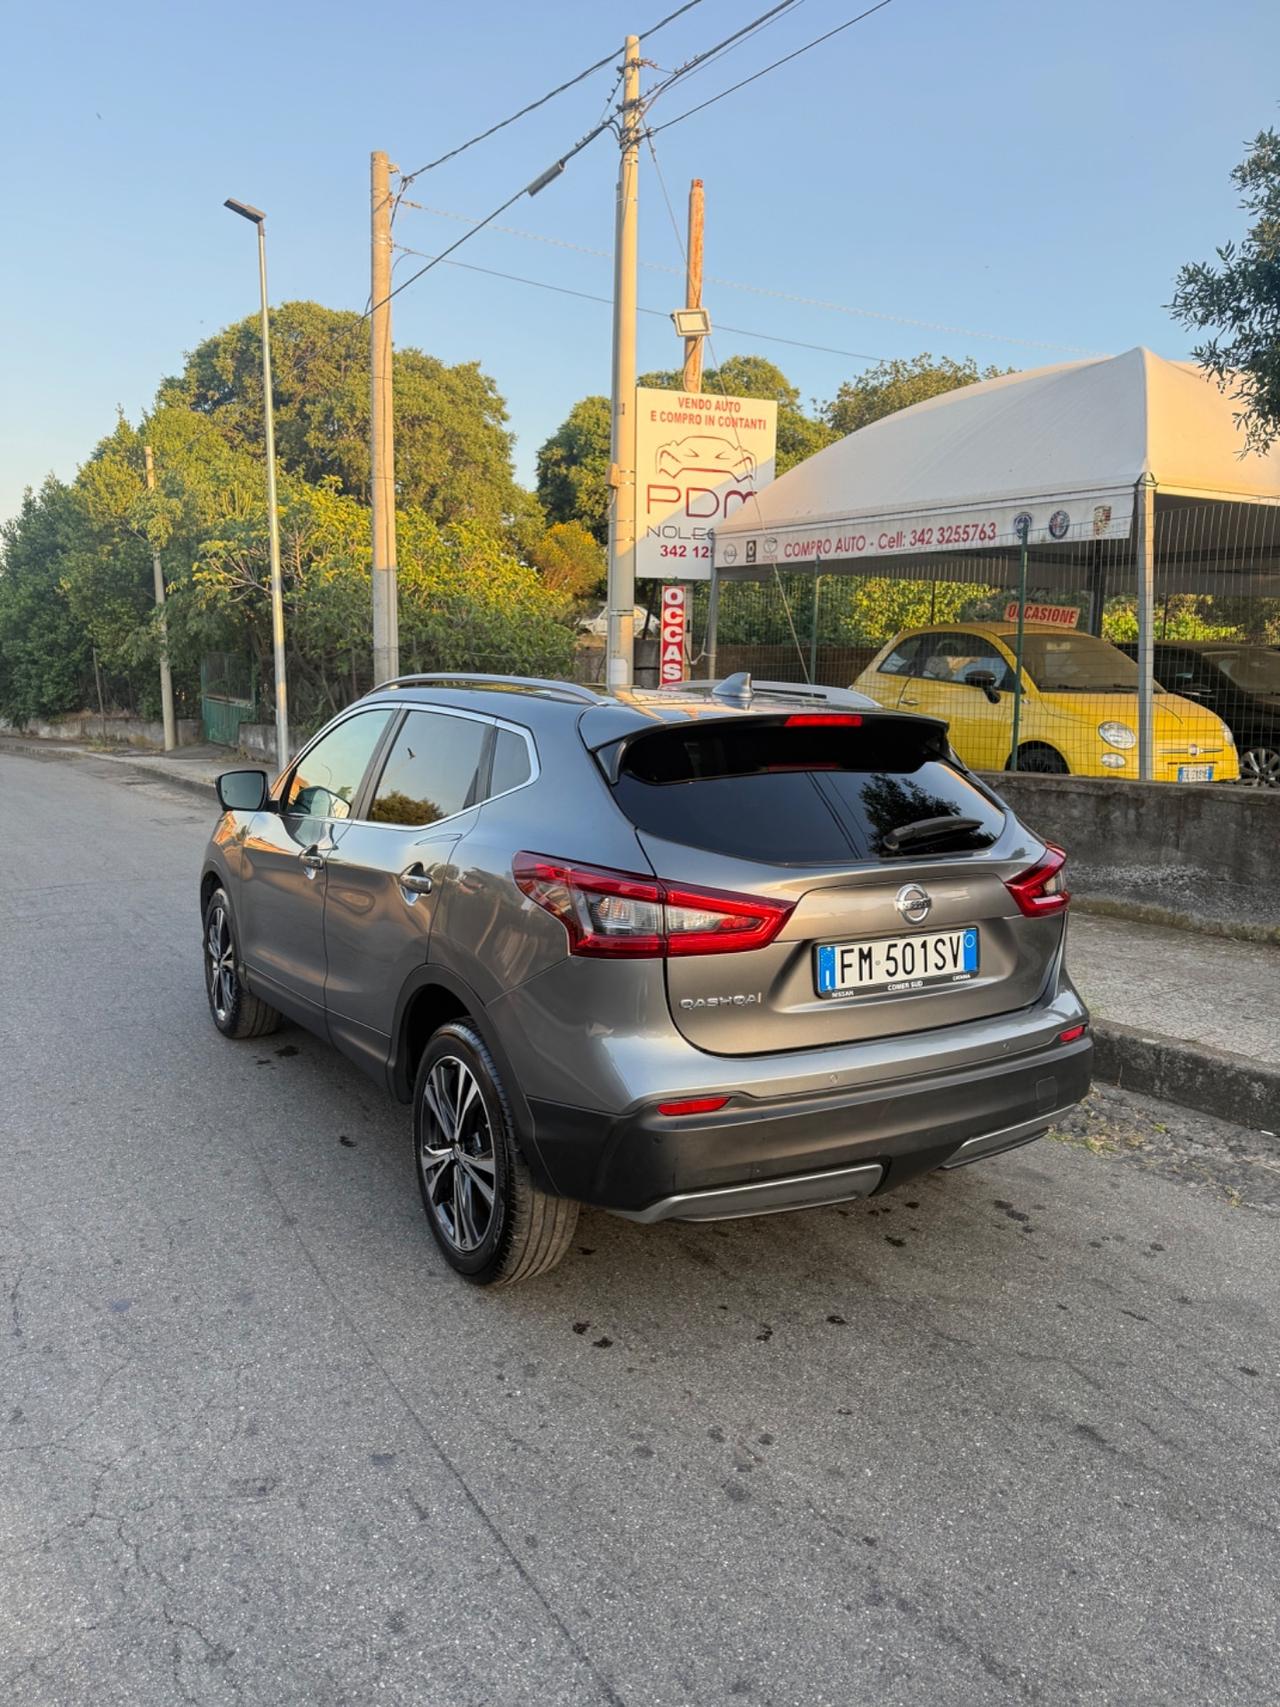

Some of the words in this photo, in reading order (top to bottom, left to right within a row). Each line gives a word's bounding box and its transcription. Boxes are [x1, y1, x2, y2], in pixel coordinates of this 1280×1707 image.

[678, 396, 711, 411] VENDO
[714, 399, 741, 413] AUTO
[650, 410, 657, 422] E
[659, 411, 702, 426] COMPRO
[704, 414, 715, 427] IN
[717, 415, 767, 430] CONTANTI
[783, 536, 833, 558] COMPRO
[834, 535, 866, 554] AUTO
[877, 528, 906, 550] Cell:
[909, 527, 933, 547] 342
[937, 521, 997, 545] 3255763
[660, 544, 687, 558] 342
[840, 945, 874, 985] FM
[884, 935, 961, 978] 501SV
[679, 992, 762, 1012] QASHQAI
[832, 988, 856, 999] NISSAN
